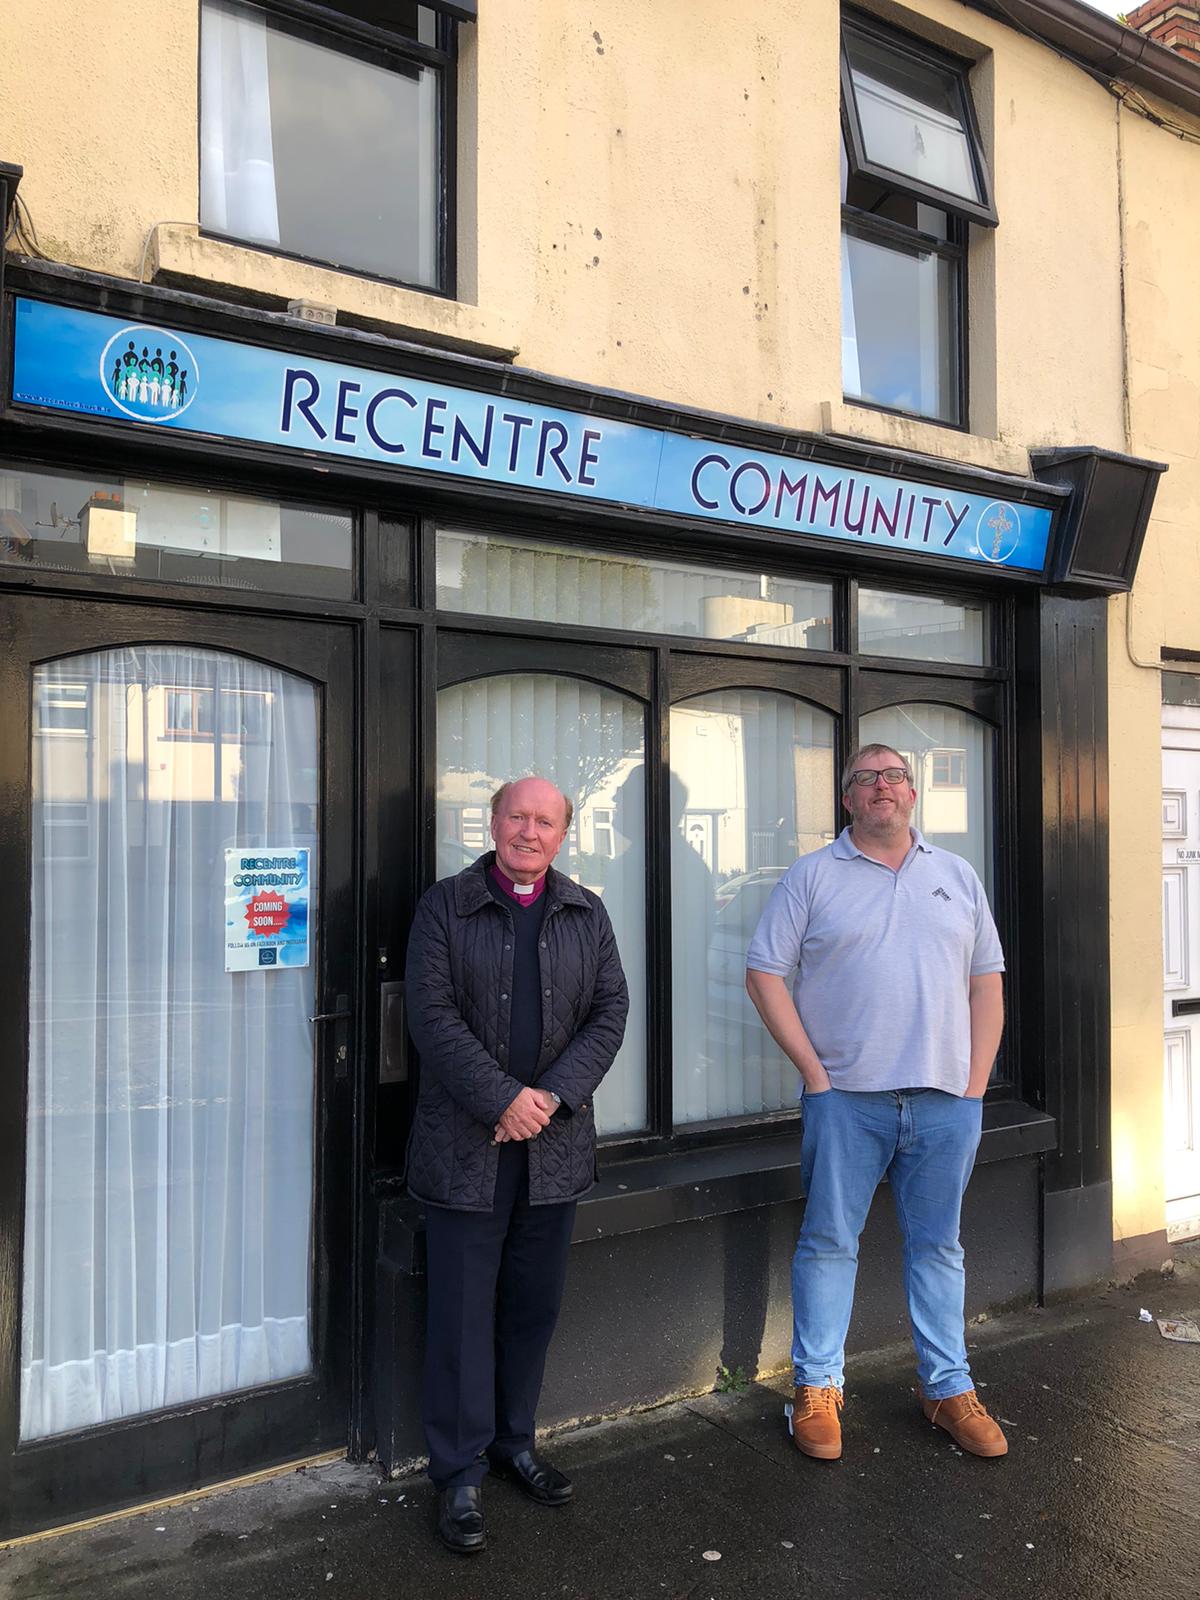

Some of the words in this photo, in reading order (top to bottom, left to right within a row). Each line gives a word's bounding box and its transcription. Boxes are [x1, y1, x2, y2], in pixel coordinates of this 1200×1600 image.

[281, 367, 603, 487] RECENTRE
[690, 452, 971, 547] COMMUNITY
[1178, 850, 1185, 858] NO
[240, 857, 297, 870] RECENTRE
[233, 873, 303, 887] COMMUNITY
[253, 902, 283, 912] COMING
